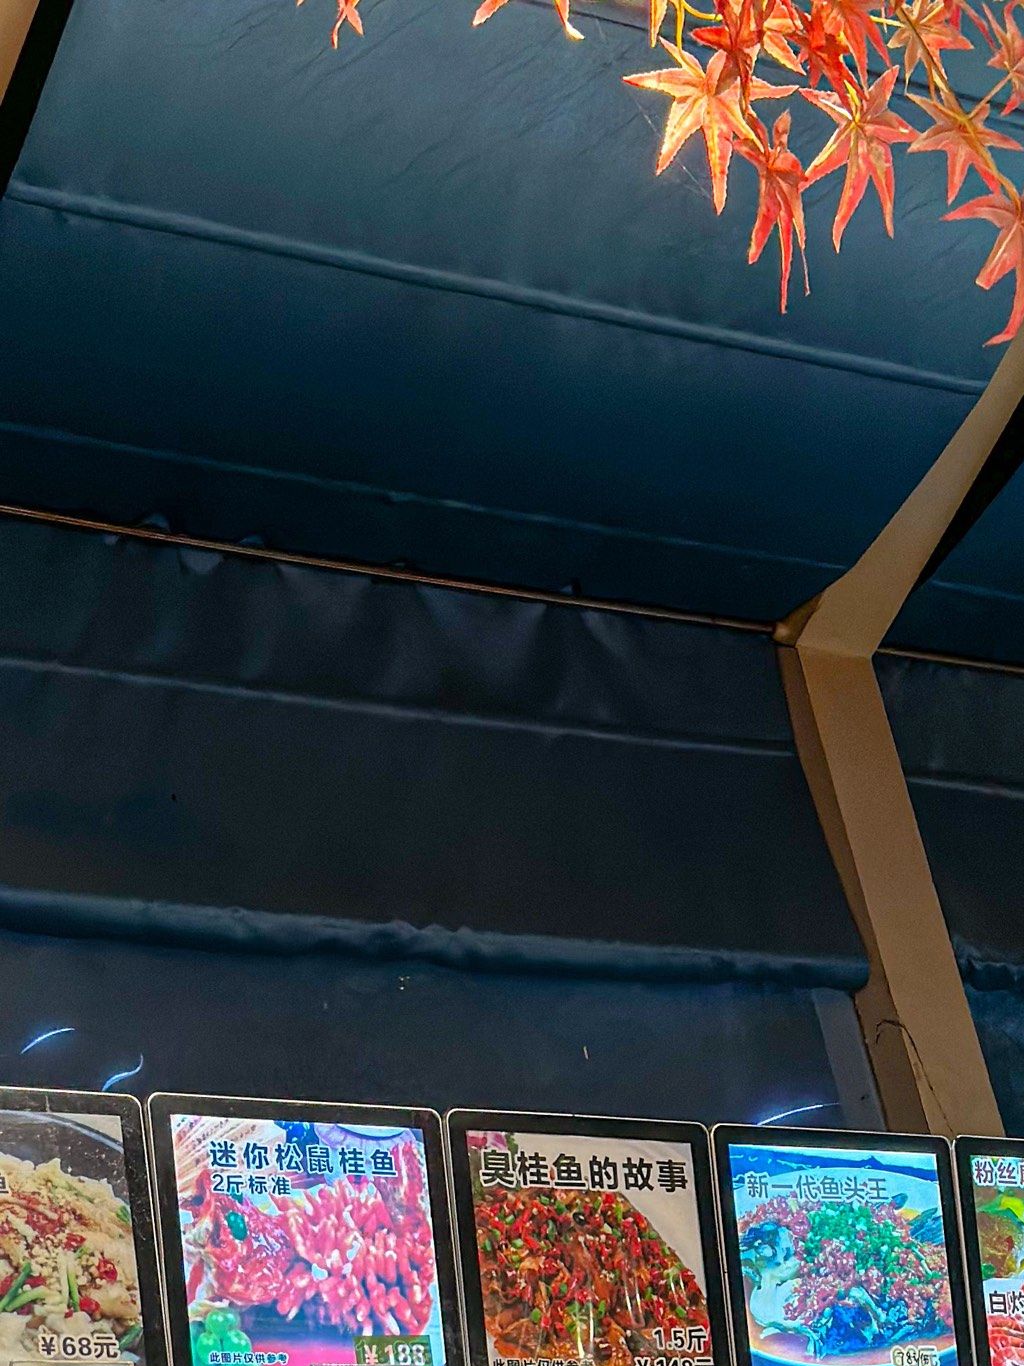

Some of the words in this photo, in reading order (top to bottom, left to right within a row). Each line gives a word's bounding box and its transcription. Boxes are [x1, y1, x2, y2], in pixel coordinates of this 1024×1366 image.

[209, 1140, 398, 1176] 迷你松鼠桂鱼
[481, 1149, 688, 1192] 臭桂鱼的故事
[212, 1173, 292, 1196] 2斤标准
[747, 1172, 889, 1200] 新一代鱼头王
[40, 1335, 119, 1358] ¥68元
[653, 1327, 706, 1352] 1.5斤
[209, 1351, 289, 1365] 此图片仅供参考
